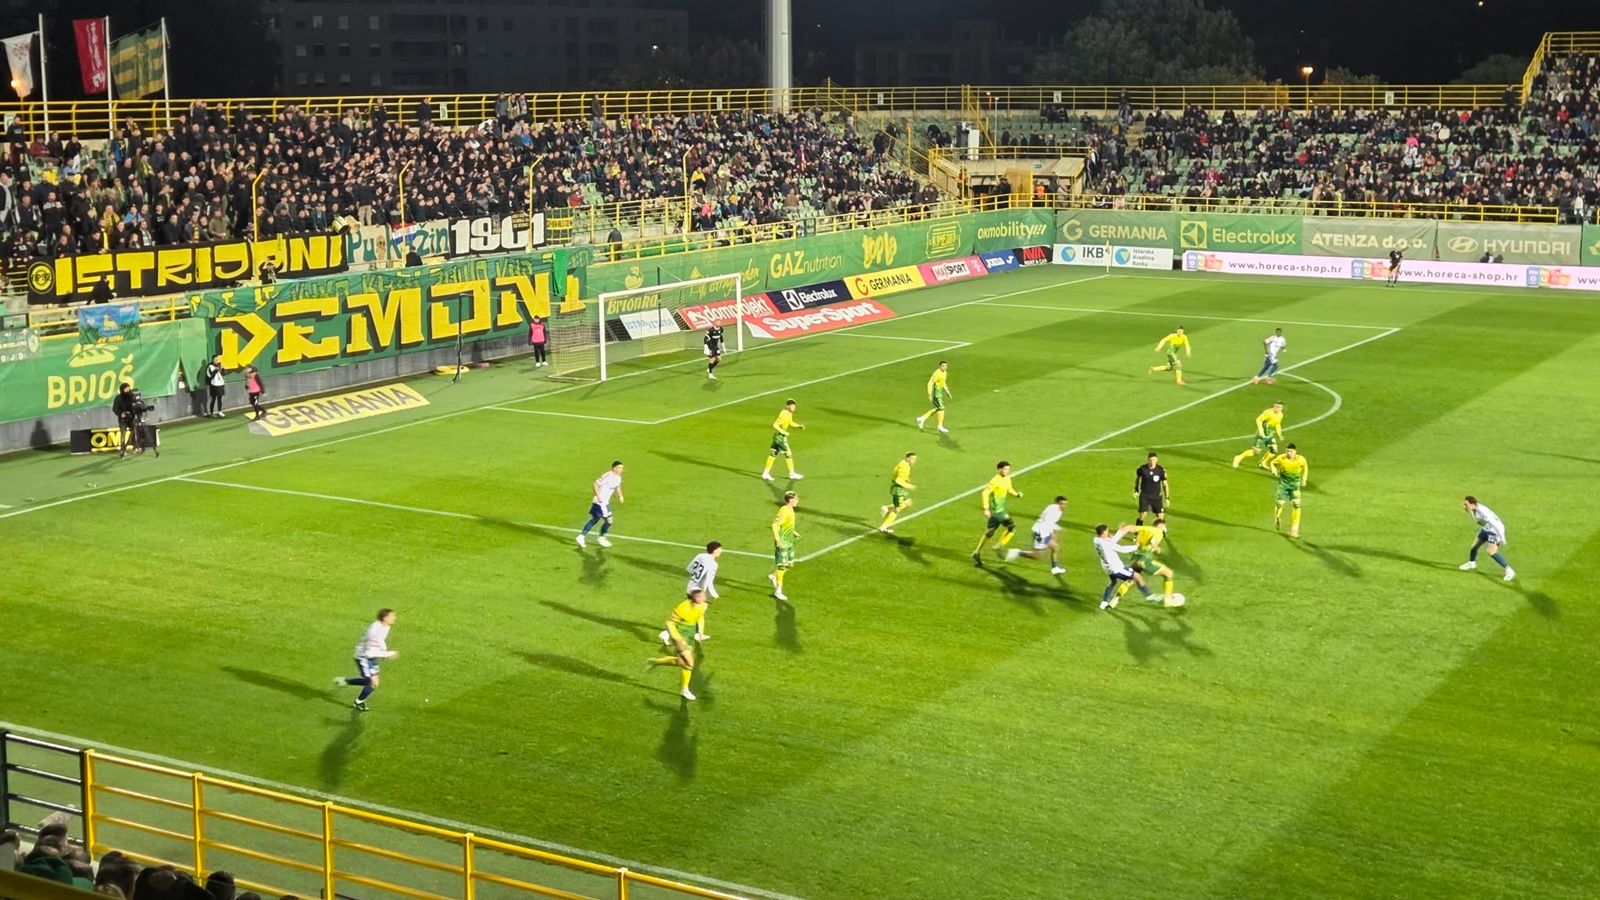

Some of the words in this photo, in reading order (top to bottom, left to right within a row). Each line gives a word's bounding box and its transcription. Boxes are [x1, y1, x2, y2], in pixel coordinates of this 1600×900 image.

[1089, 224, 1168, 241] GERMANIA
[1212, 228, 1296, 245] Electrolux
[1312, 232, 1379, 248] ATENZA
[1082, 246, 1104, 259] IKB
[1483, 239, 1571, 255] HYUNDAI
[1229, 261, 1342, 275] www.horeca-shop.hr
[869, 273, 913, 291] GERMANIA
[799, 287, 838, 303] Electrolux
[762, 301, 882, 332] SuperSport
[47, 353, 135, 409] BRIOŠ
[262, 385, 419, 430] GERMANIA
